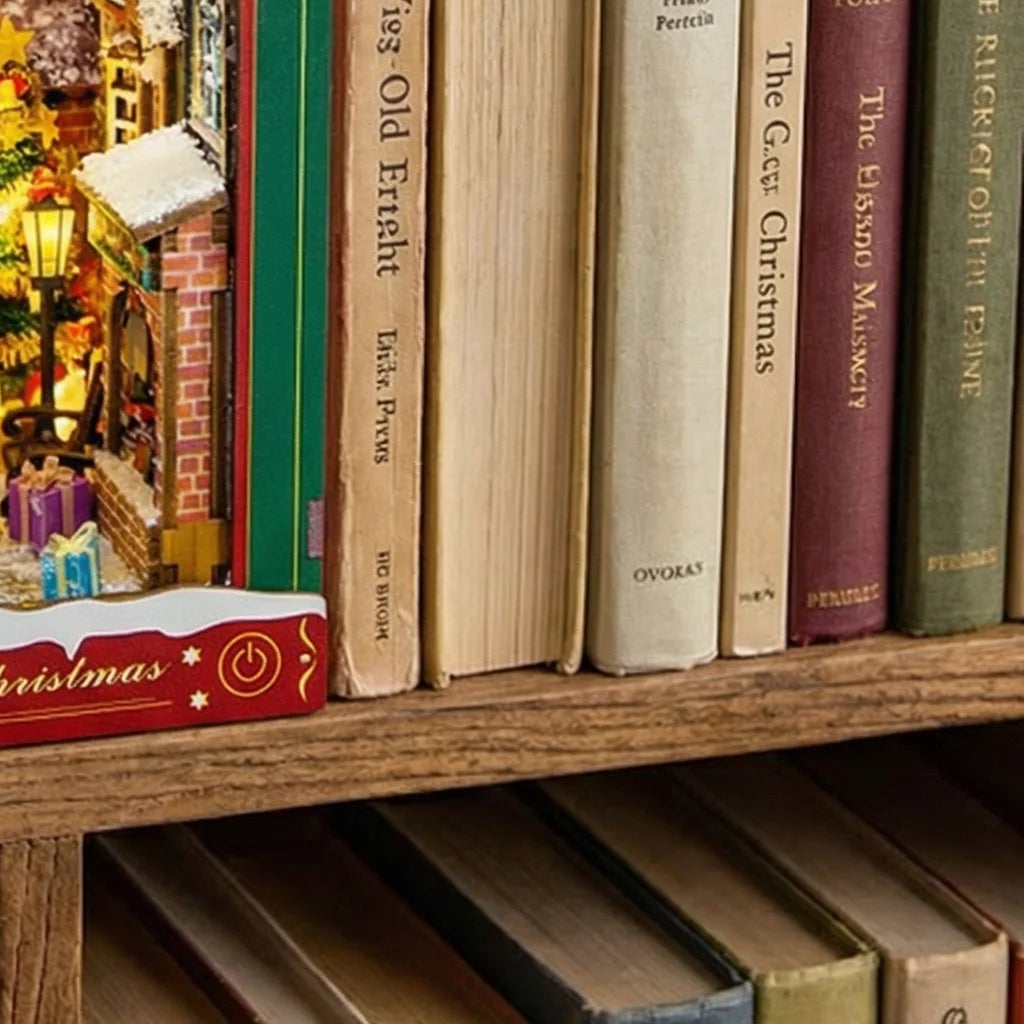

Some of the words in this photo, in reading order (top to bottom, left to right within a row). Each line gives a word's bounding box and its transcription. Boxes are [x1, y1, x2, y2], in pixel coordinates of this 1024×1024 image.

[764, 41, 793, 108] The
[858, 86, 885, 150] The
[755, 211, 789, 375] Christmas
